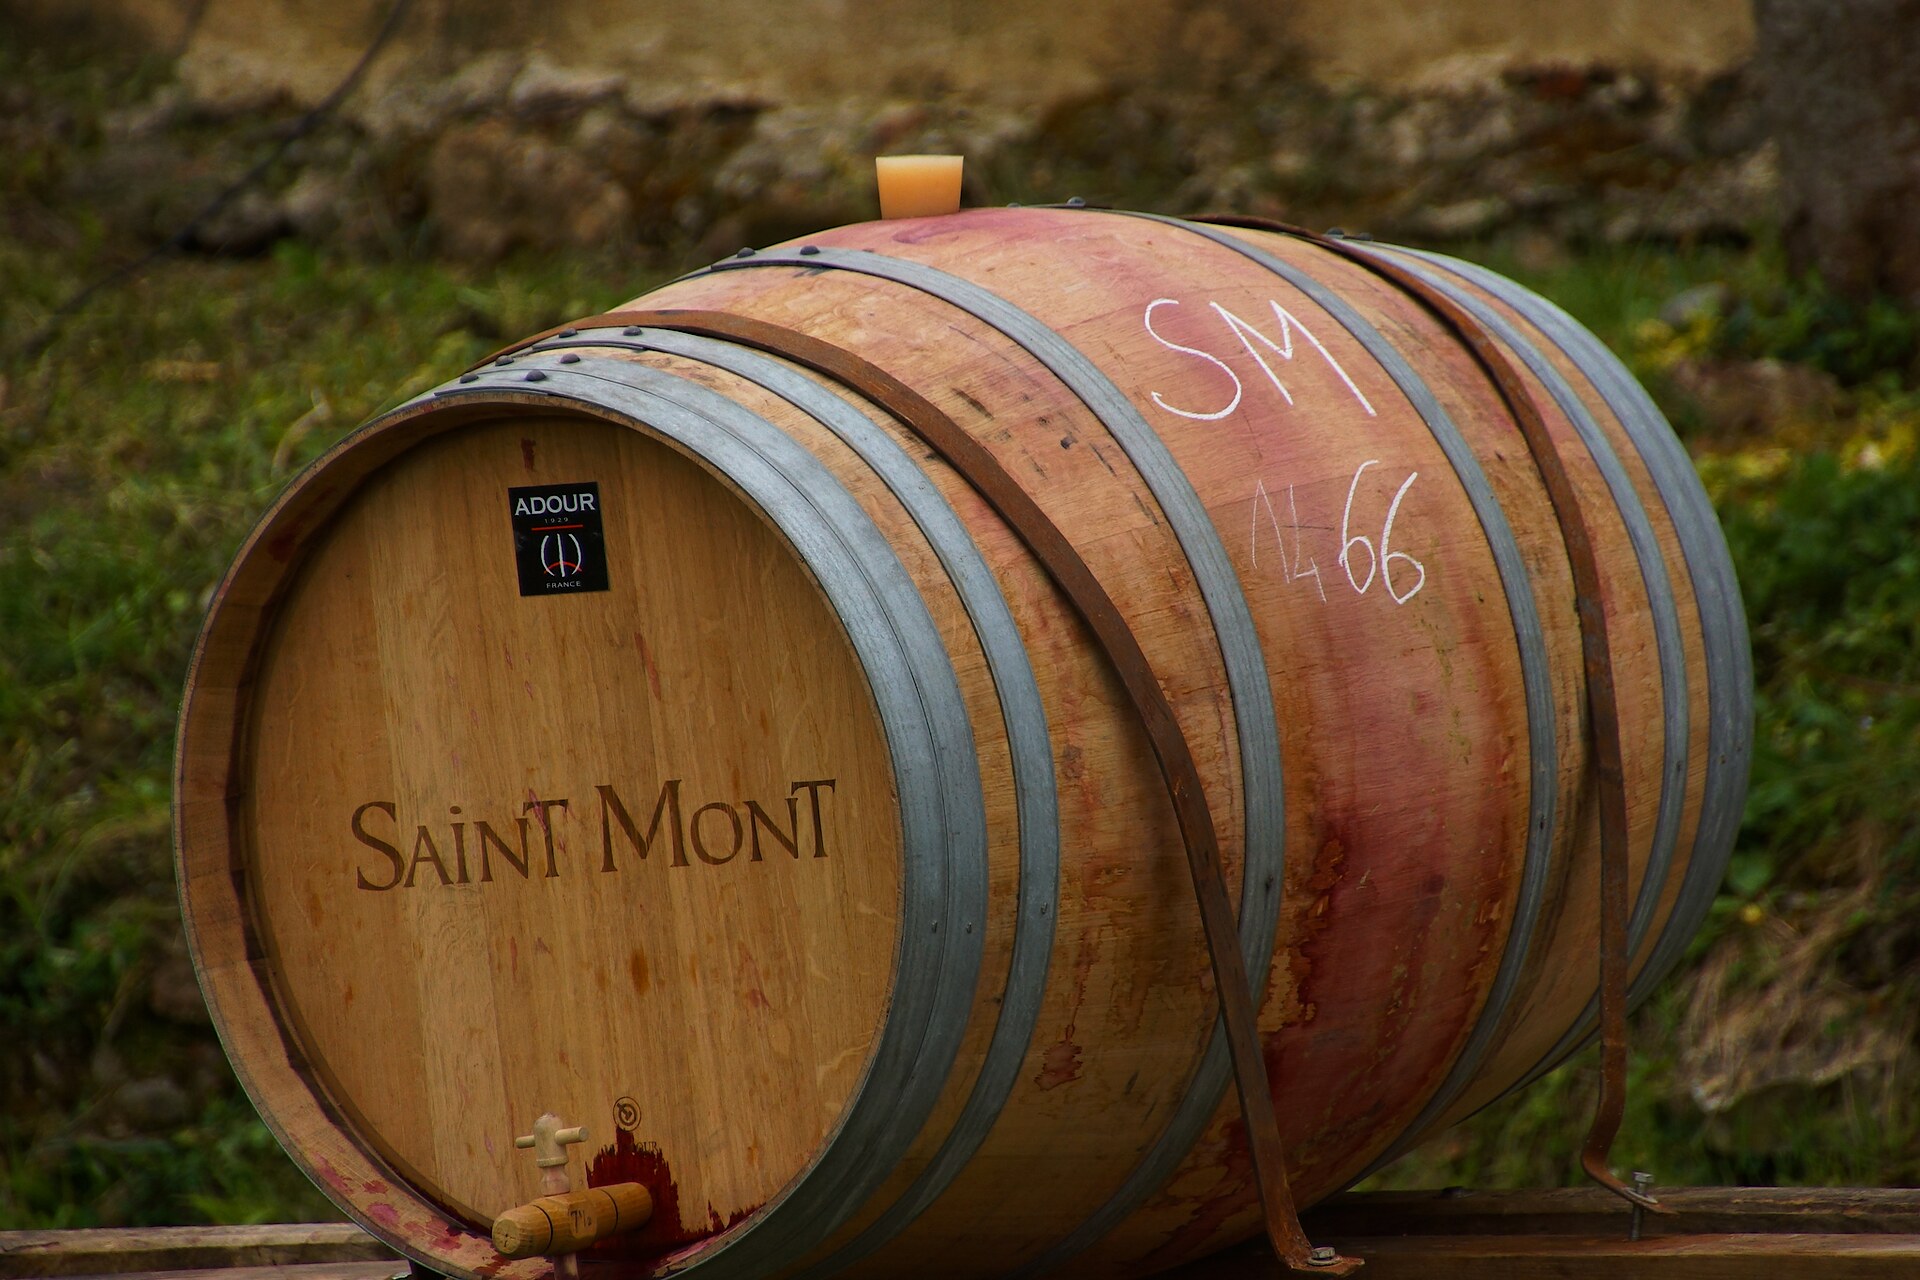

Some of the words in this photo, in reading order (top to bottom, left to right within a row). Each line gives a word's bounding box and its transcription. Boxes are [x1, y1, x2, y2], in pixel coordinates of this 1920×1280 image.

[1144, 297, 1377, 420] SM
[514, 493, 595, 516] ADOUR
[544, 516, 569, 524] 1929
[1338, 459, 1426, 605] 66
[546, 580, 581, 589] FRANCE
[595, 779, 836, 873] MONT
